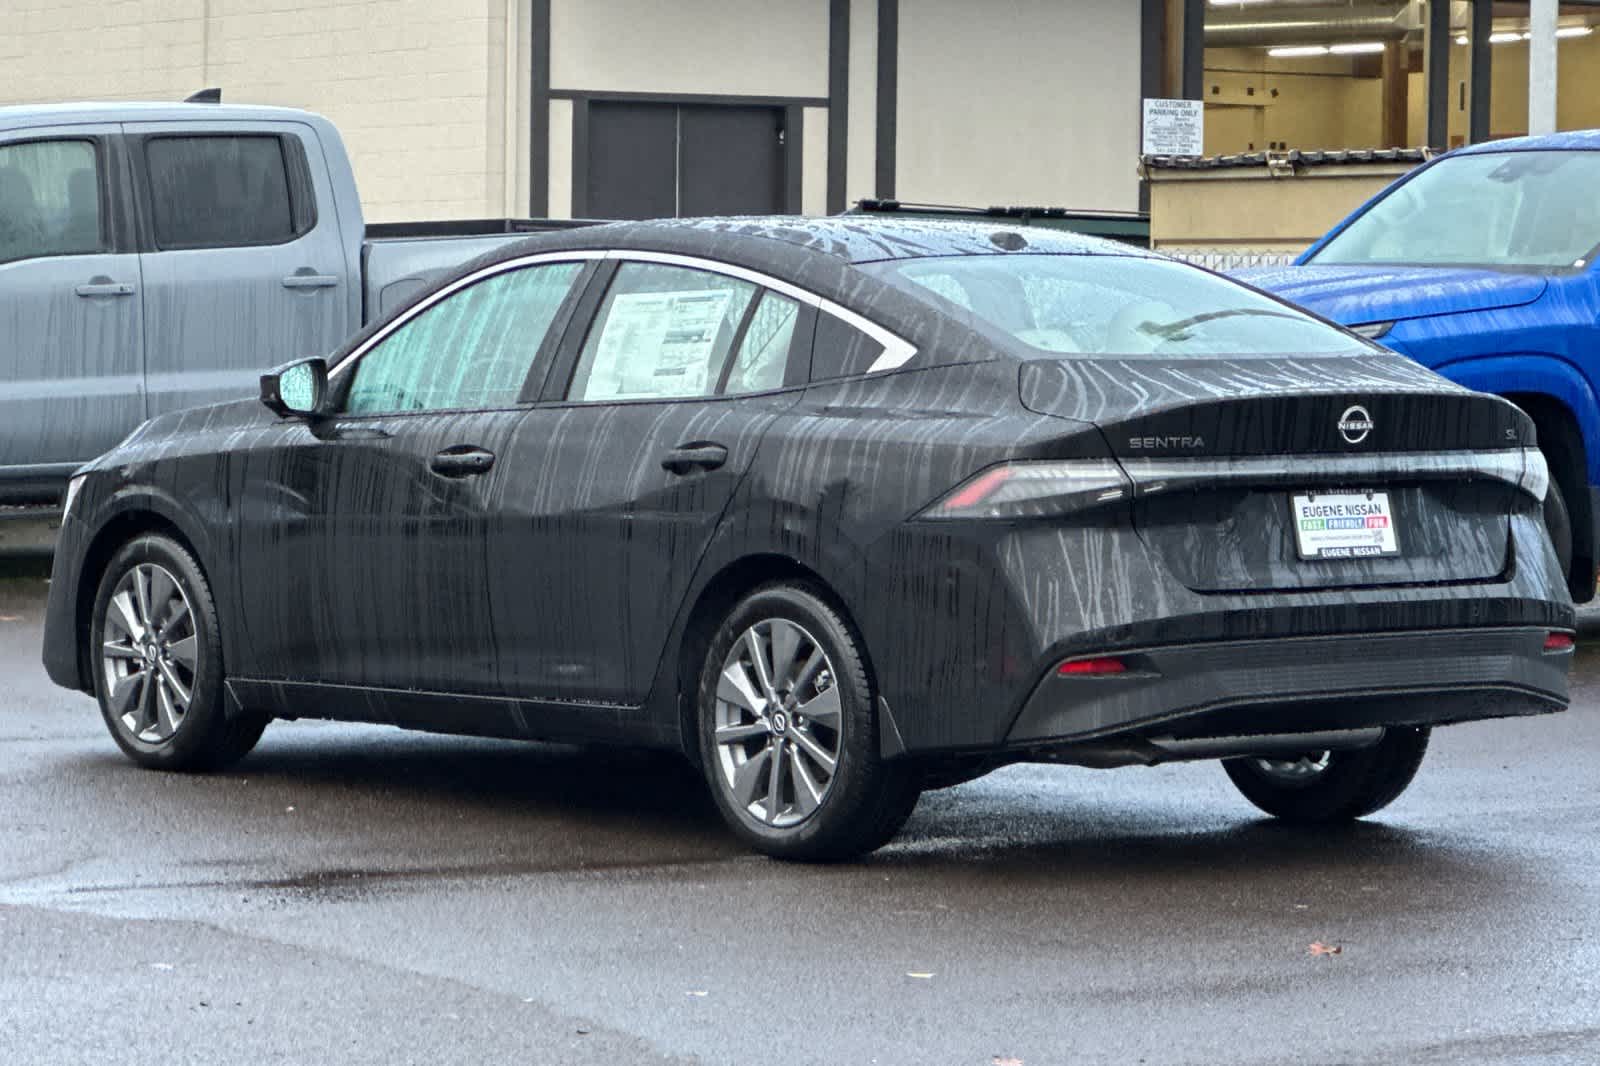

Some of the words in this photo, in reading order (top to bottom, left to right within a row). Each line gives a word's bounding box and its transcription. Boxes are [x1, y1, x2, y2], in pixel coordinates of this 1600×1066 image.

[1155, 100, 1192, 108] CUSTOMER
[1149, 108, 1179, 116] PARKING
[1180, 109, 1198, 117] ONLY
[1338, 422, 1374, 430] NISSAN
[1129, 436, 1205, 448] SENTRA
[1302, 505, 1344, 517] EUGENE
[1345, 503, 1382, 516] NISSAN
[1321, 547, 1352, 557] EUGENE
[1353, 546, 1381, 555] NISSAN
